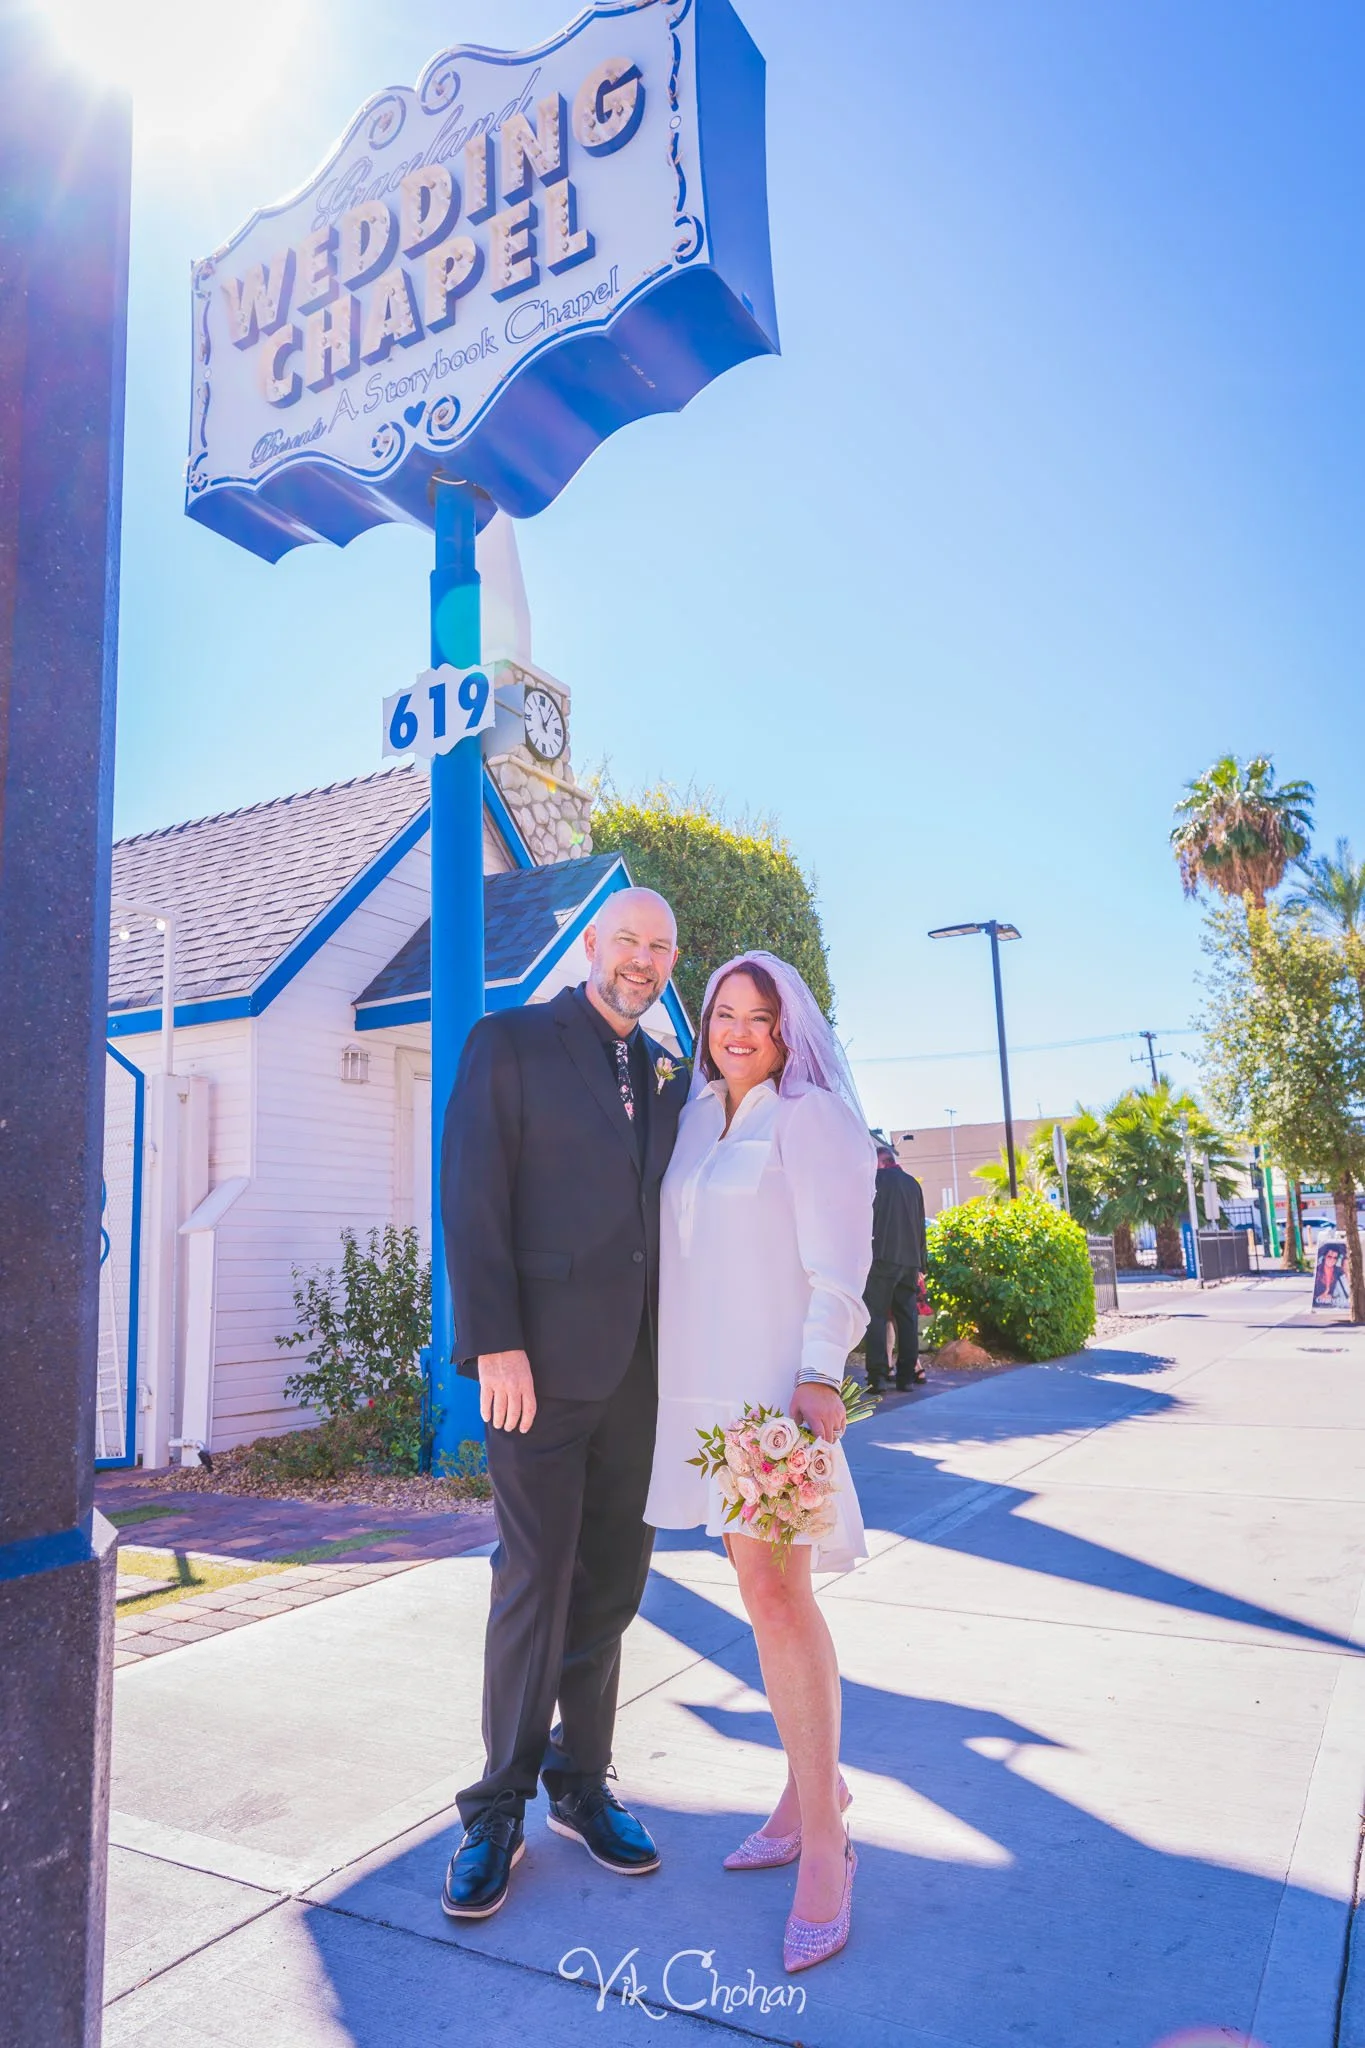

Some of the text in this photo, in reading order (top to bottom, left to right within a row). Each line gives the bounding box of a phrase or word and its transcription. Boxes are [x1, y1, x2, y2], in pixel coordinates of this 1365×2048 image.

[220, 56, 646, 351] WEDDING
[311, 67, 541, 232] Graceland
[258, 178, 594, 409] CHAPEL
[328, 389, 359, 433] A
[363, 327, 499, 414] Storybook
[504, 264, 620, 345] Chapel
[389, 672, 490, 749] 619
